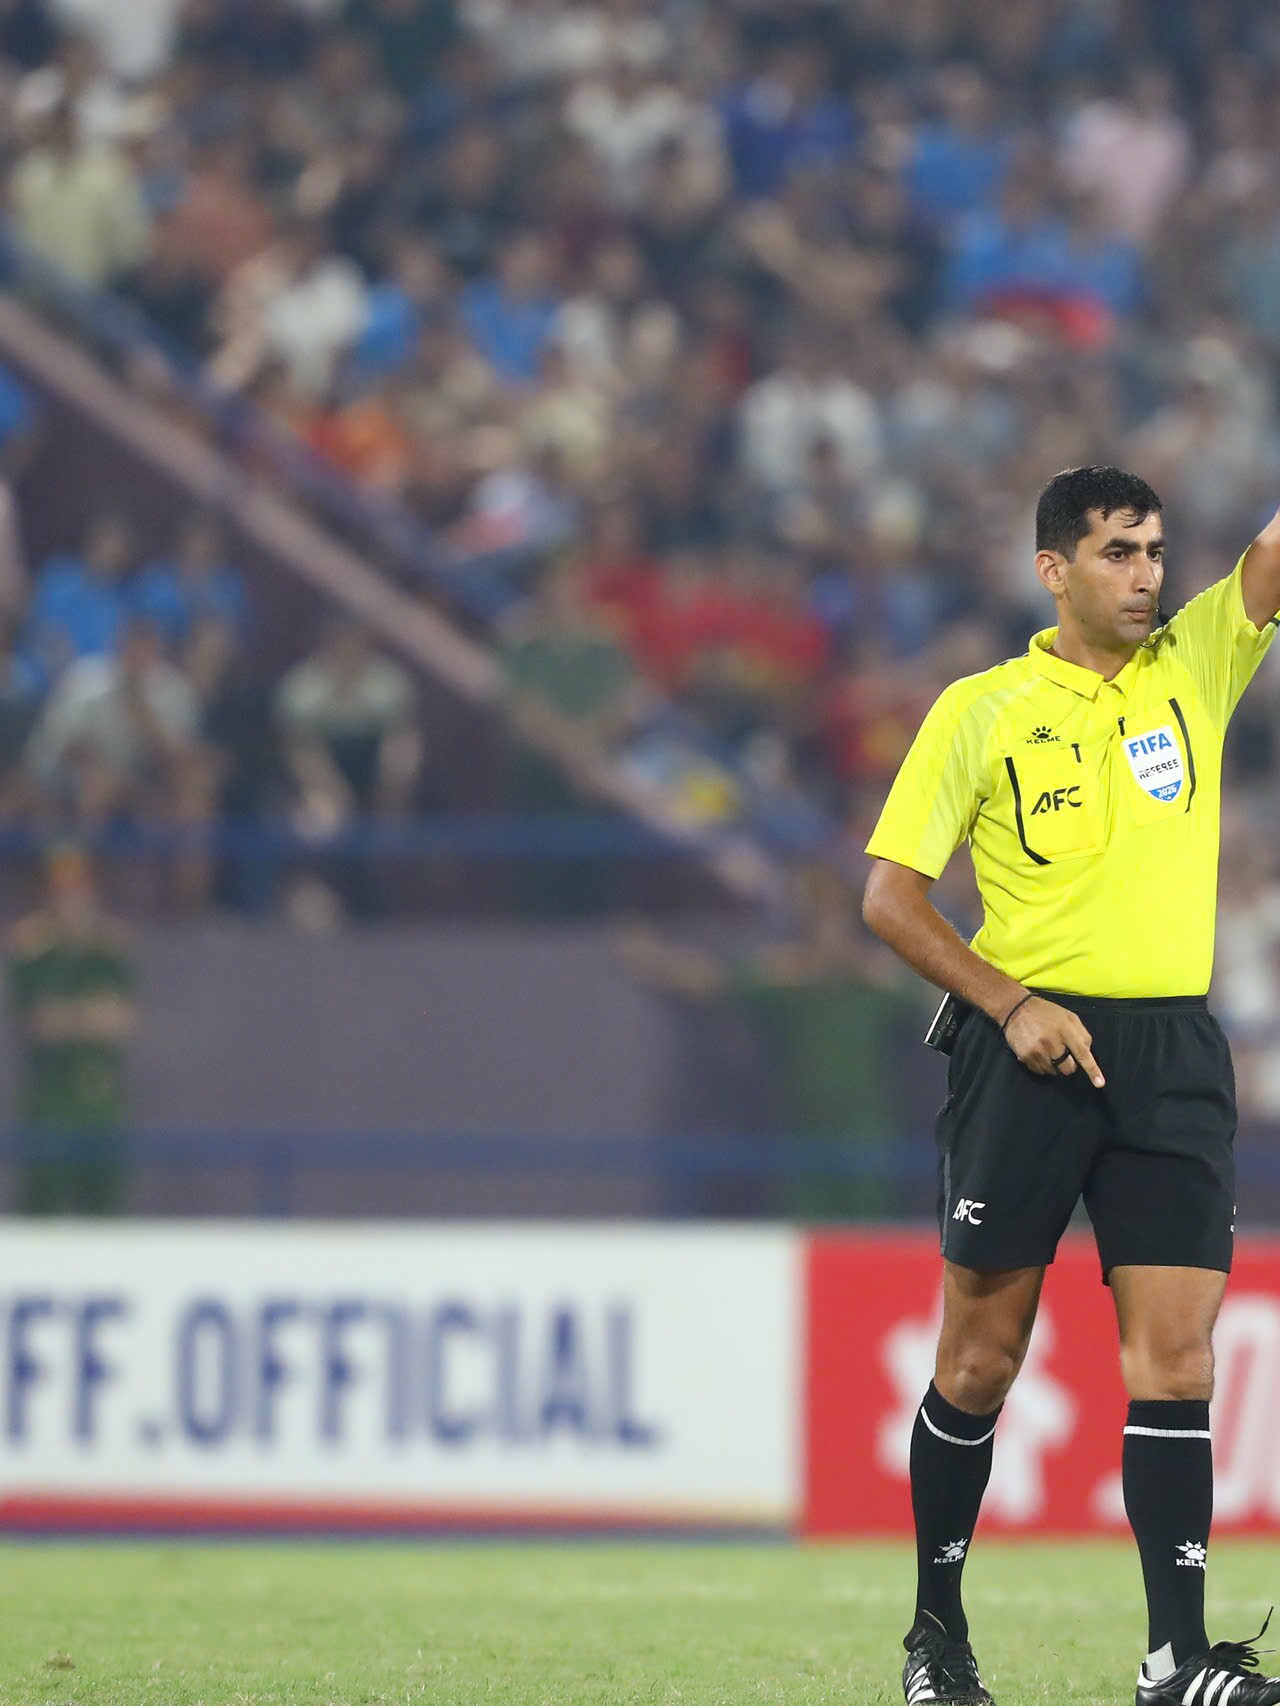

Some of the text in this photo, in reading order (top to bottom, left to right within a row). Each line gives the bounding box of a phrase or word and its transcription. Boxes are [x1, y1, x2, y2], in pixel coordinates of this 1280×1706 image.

[1026, 735, 1061, 744] KELME
[1128, 733, 1172, 758] FIFA
[1030, 785, 1083, 815] AFC
[952, 1198, 986, 1226] AFC
